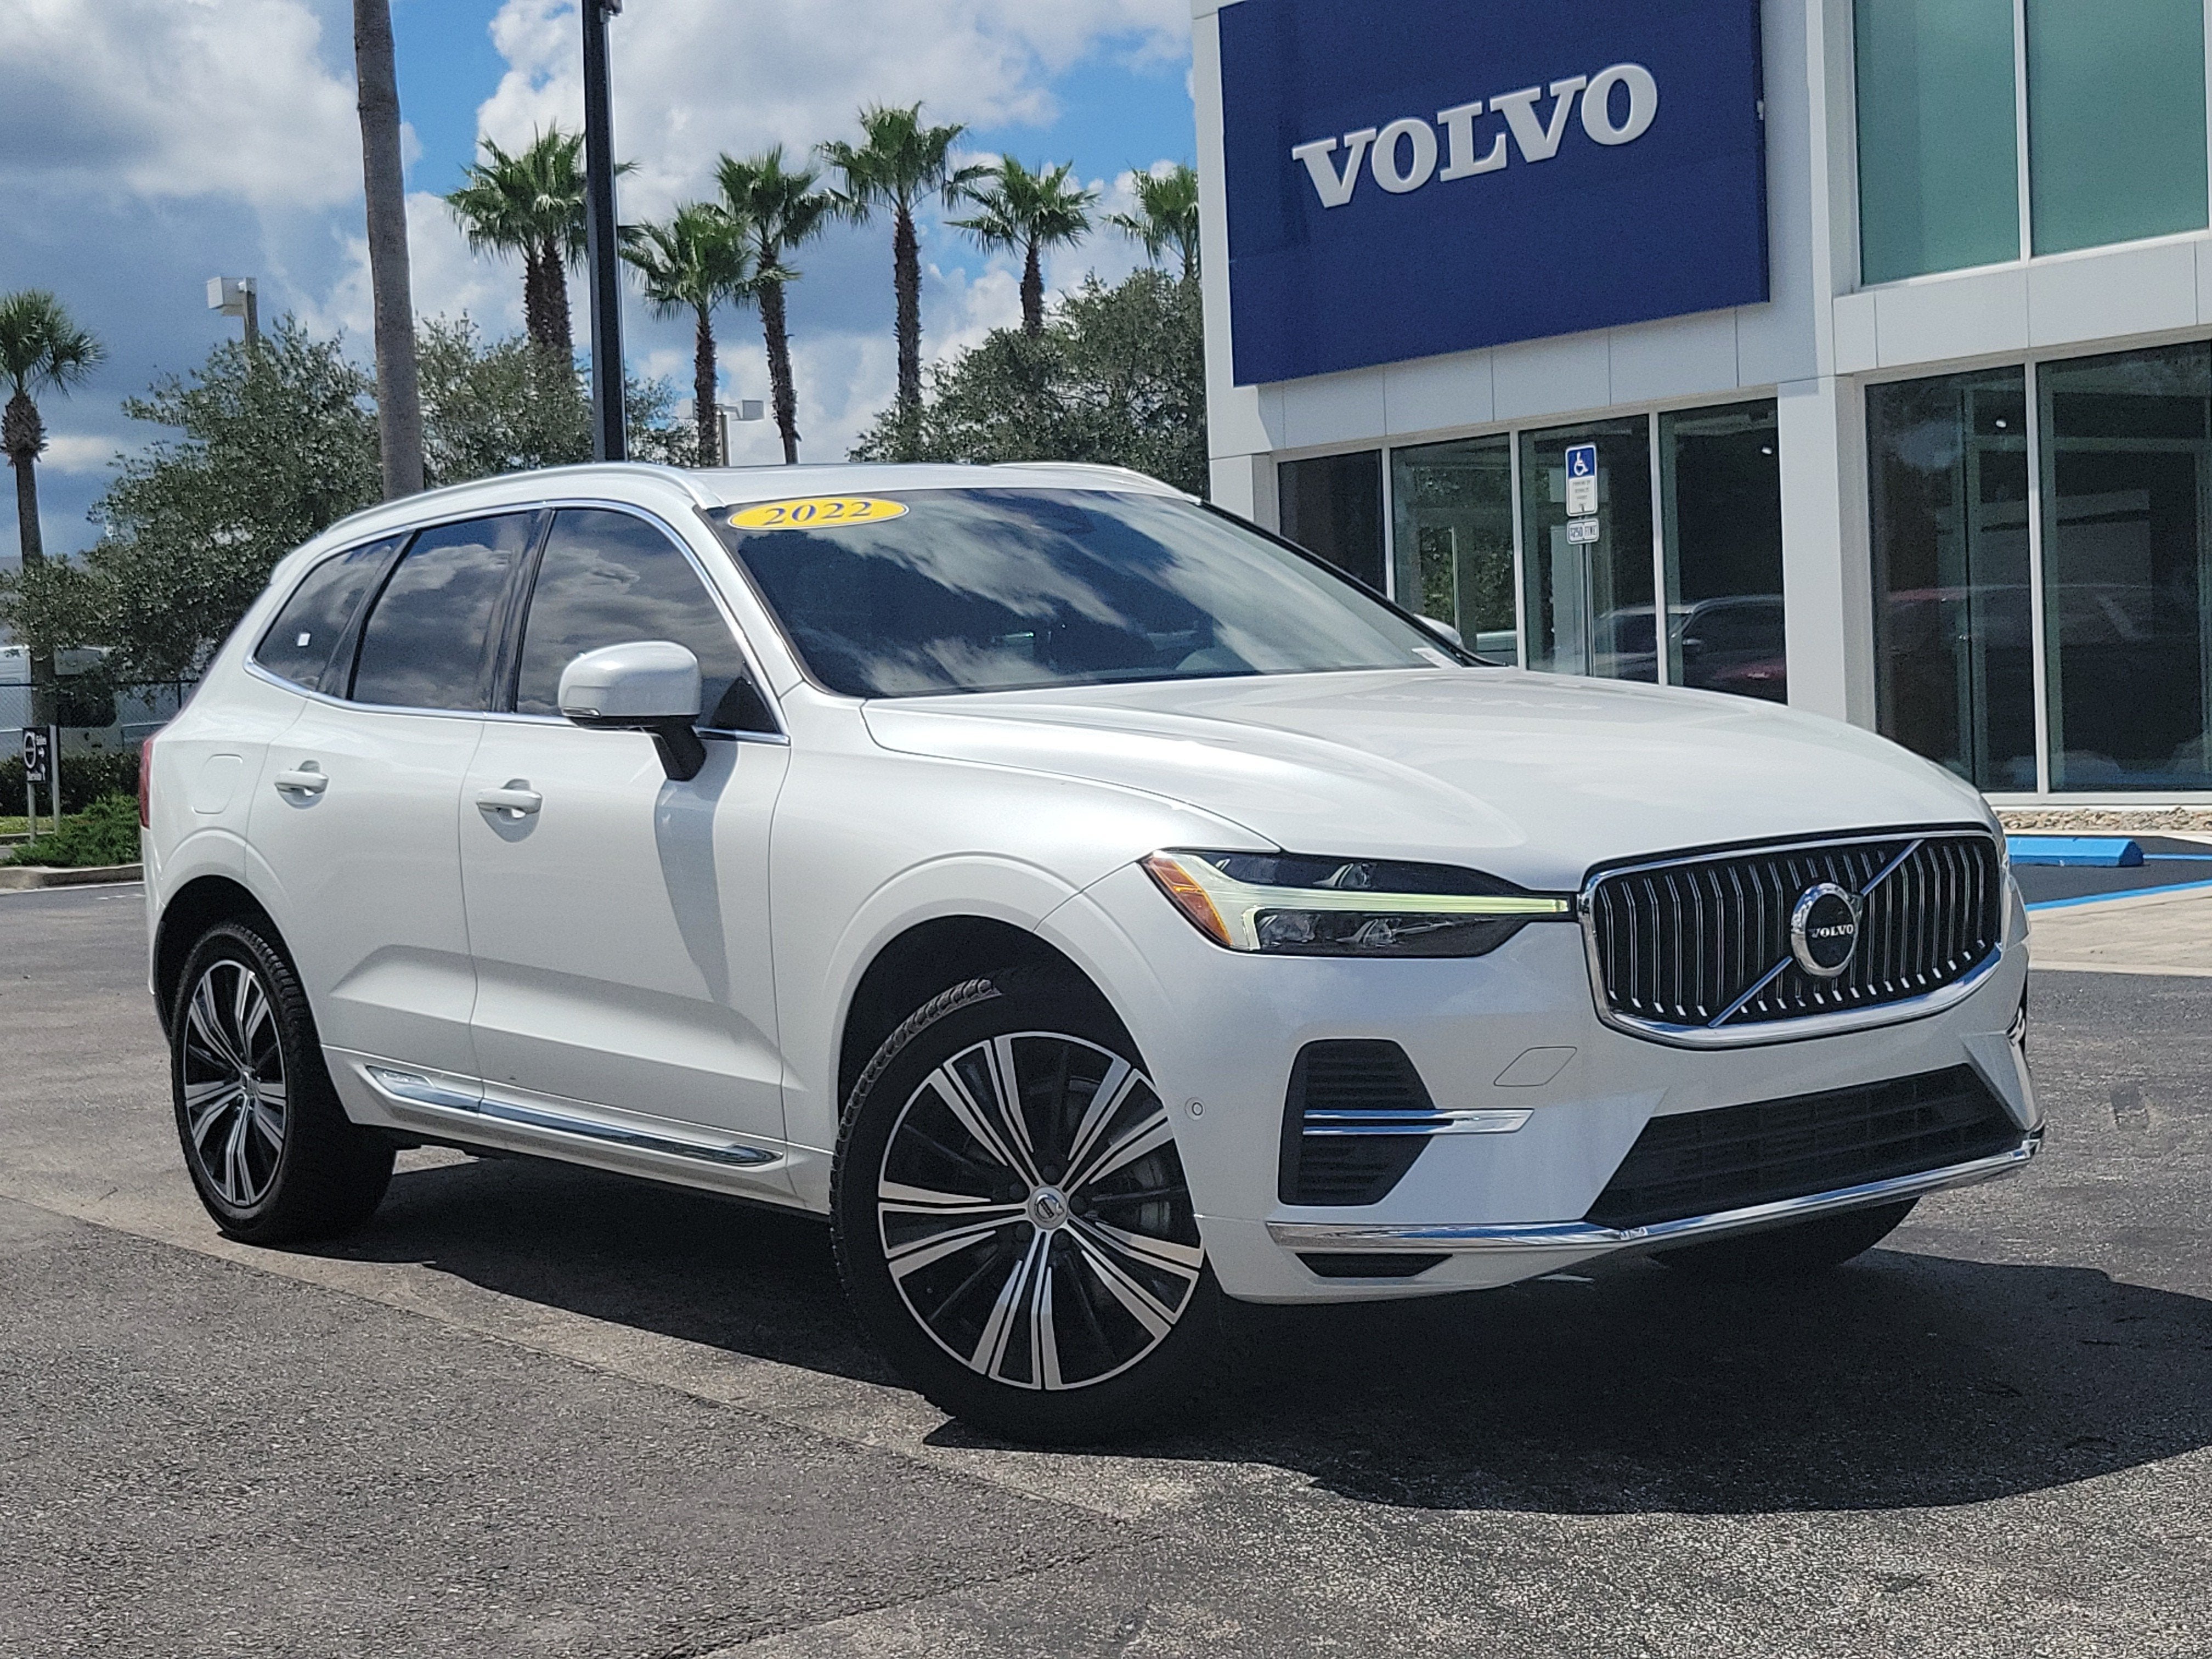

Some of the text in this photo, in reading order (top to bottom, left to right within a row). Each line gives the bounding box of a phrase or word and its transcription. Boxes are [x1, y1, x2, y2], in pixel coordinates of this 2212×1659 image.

[1291, 63, 1658, 208] VOLVO
[763, 501, 872, 525] 2022
[1808, 924, 1854, 938] VOLVO
